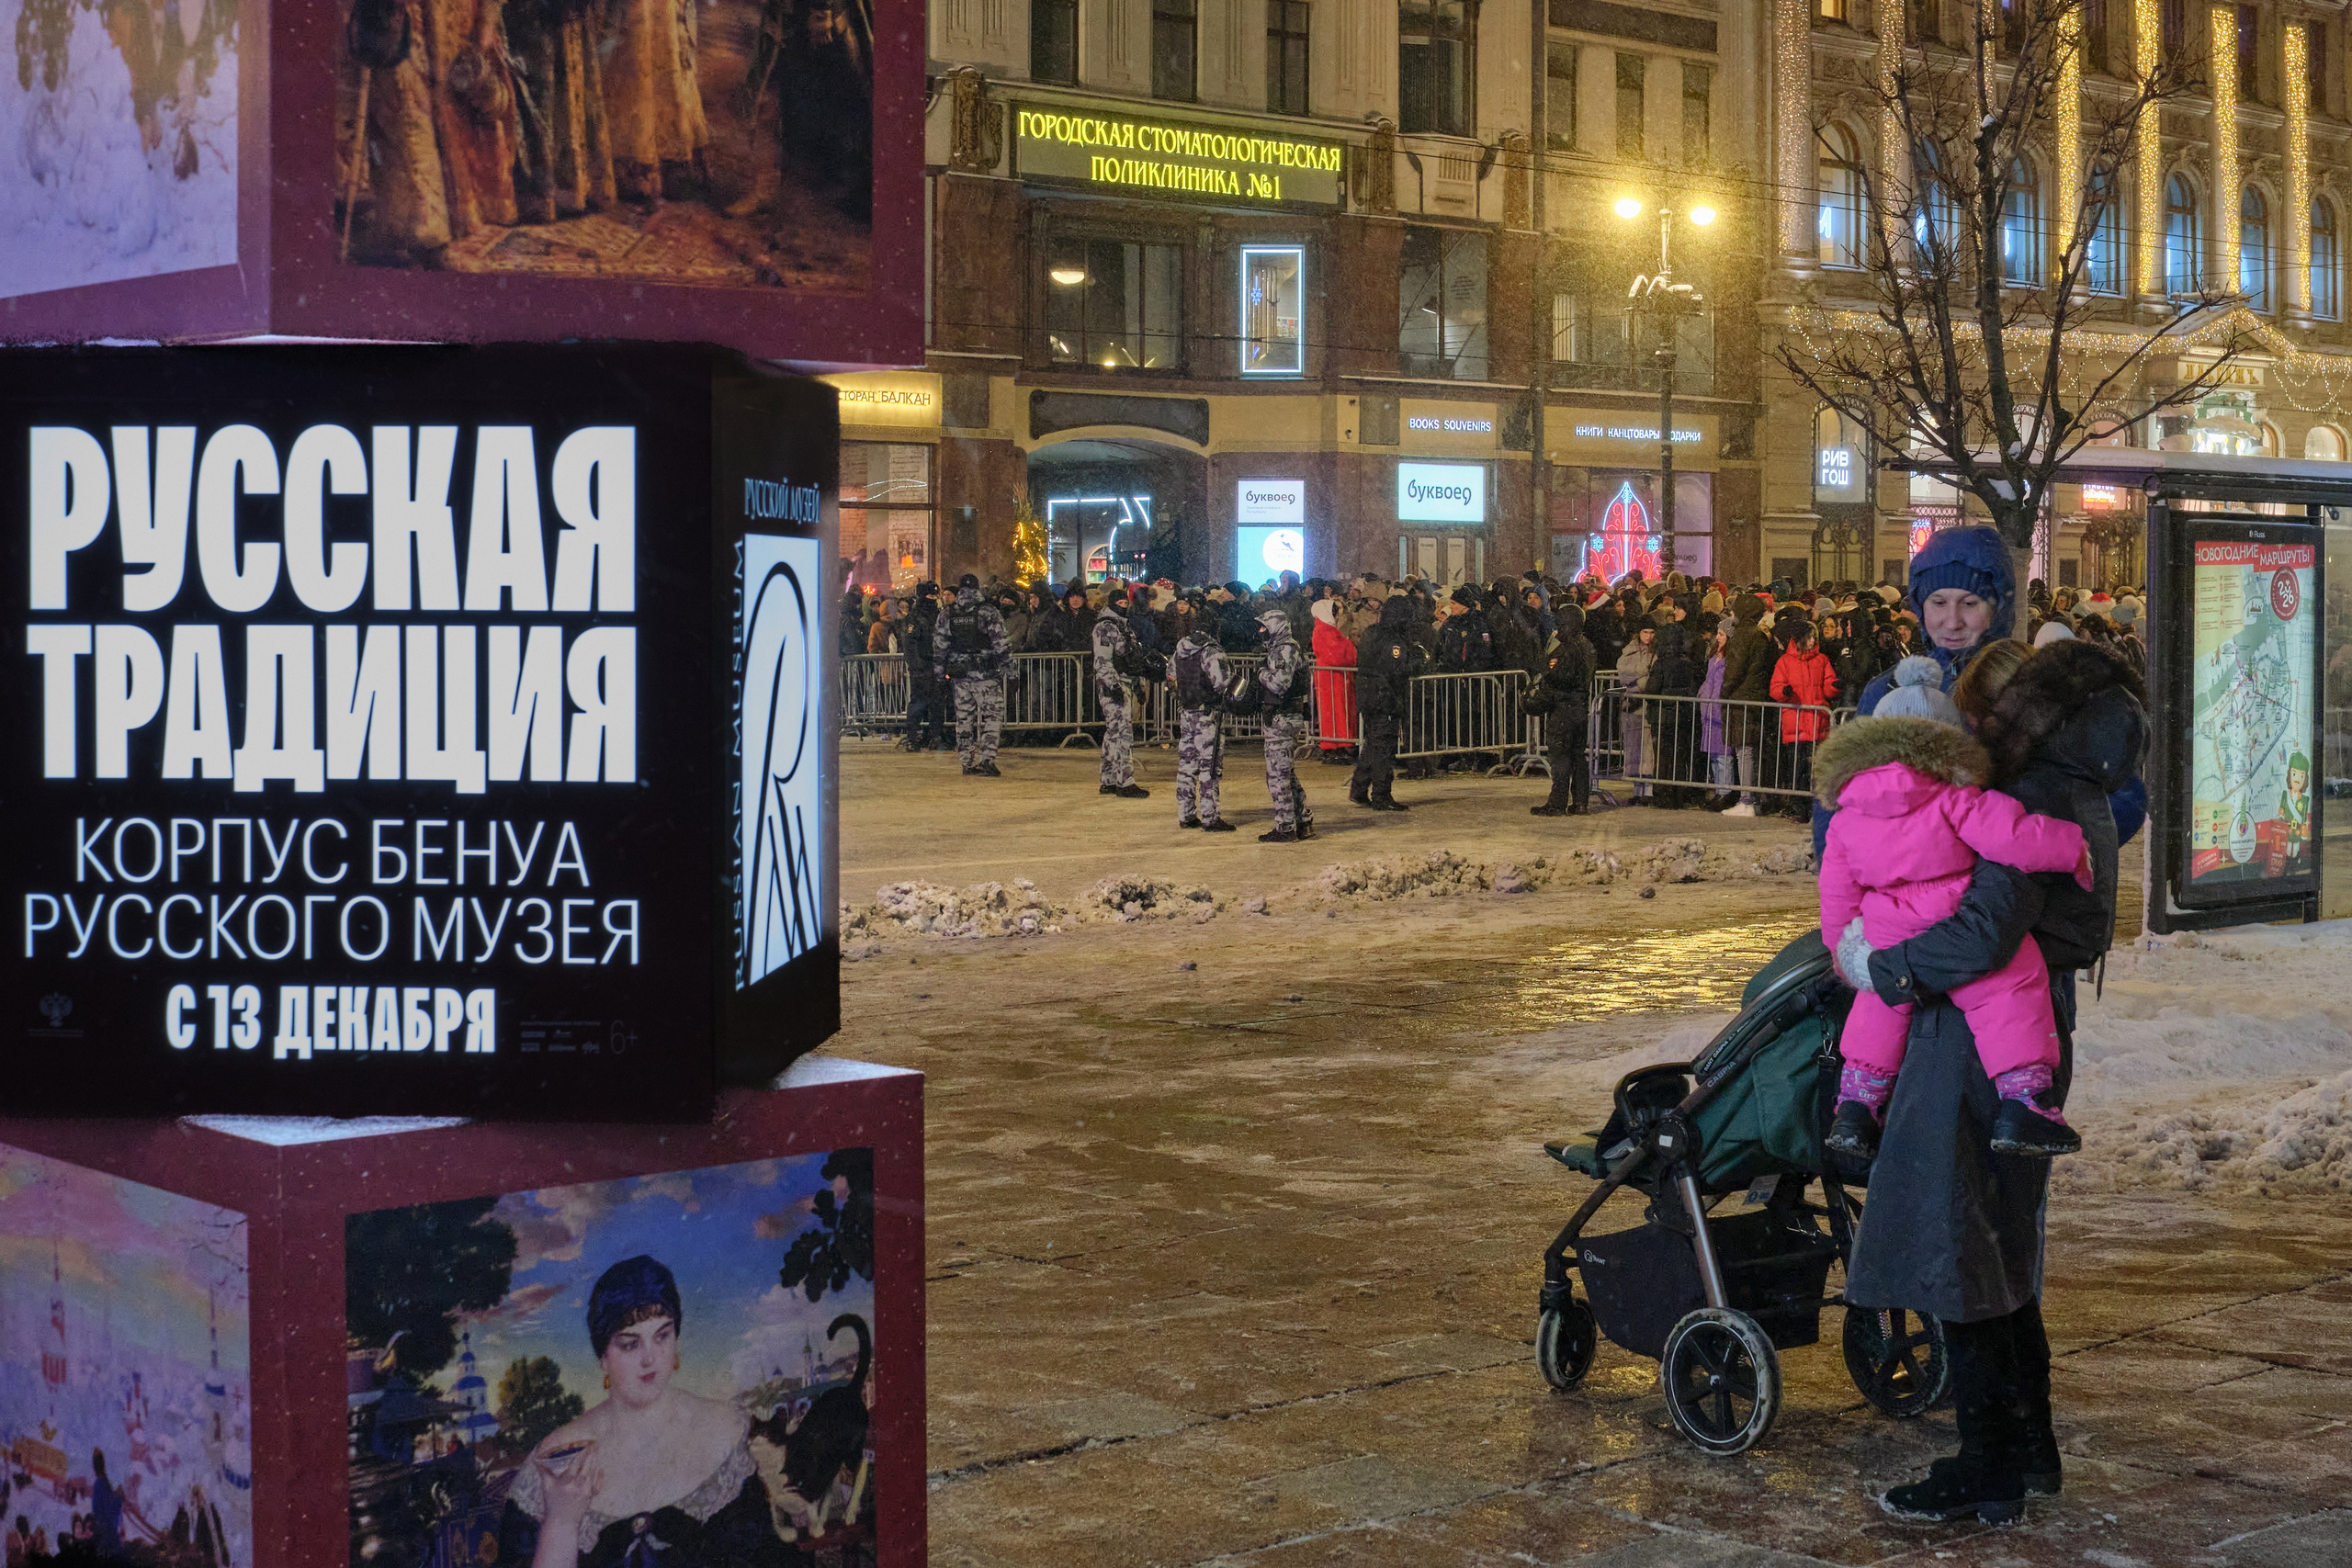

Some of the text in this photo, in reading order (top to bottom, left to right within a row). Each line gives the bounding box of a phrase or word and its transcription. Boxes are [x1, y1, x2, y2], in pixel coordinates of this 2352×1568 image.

[1019, 111, 1341, 172] ГОРОДСКАЯ СТОМАТОЛОГИЧЕСКАЯ
[1091, 156, 1282, 200] ПОЛИКЛИНИКА №1
[838, 390, 931, 405] СТОРАН БАЛКАН
[1408, 418, 1491, 432] BOOKS SOUVENIRS
[1576, 426, 1701, 442] КНИГИ КАНЦТОВАРЫ ОДАРКИ
[1822, 449, 1849, 467] РИВ
[1408, 479, 1472, 506] буквоед
[1822, 468, 1849, 485] ГОШ
[744, 477, 820, 525] РУССКИЙ МУЗЕЙ
[1246, 490, 1296, 505] буквоед
[29, 423, 636, 613] РУССКАЯ
[2259, 548, 2310, 566] МАРШРУТЫ
[26, 624, 637, 795] ТРАДИЦИЯ
[732, 540, 745, 993] RUSSIAN MUSEUM
[76, 817, 590, 887] КОРПУС БЕНУА
[25, 893, 639, 965] РУССКОГО МУЗЕЯ
[166, 985, 495, 1059] С 13 ДЕКАБРЯ
[610, 1019, 638, 1054] 6+
[1707, 1061, 1736, 1089] CASPIA
